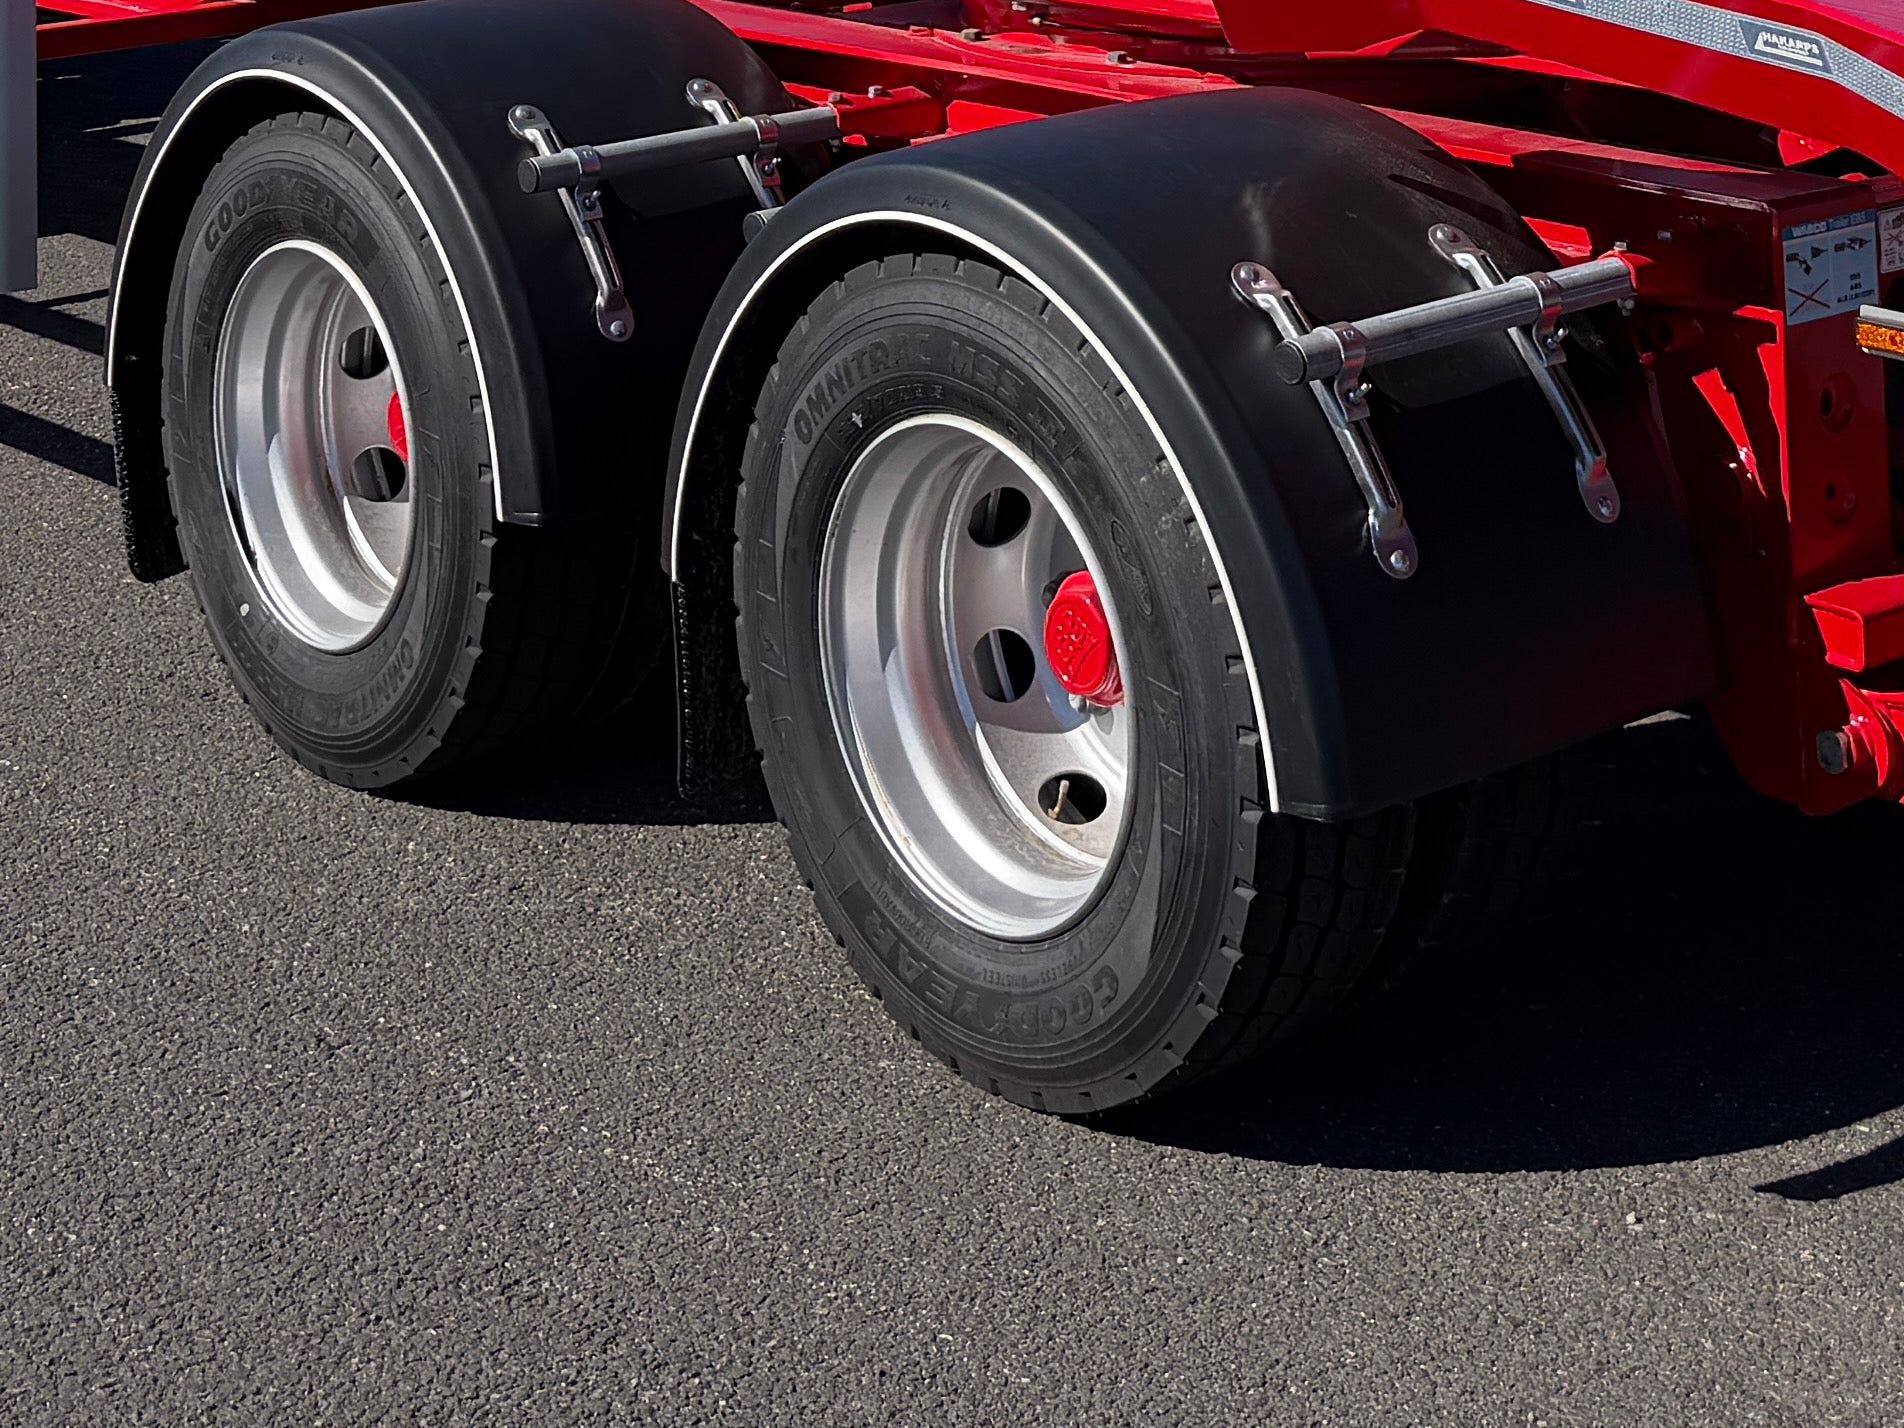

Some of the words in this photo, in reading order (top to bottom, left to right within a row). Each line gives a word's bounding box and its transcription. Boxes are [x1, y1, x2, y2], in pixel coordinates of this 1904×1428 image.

[1762, 32, 1821, 55] HAKARPS
[204, 175, 359, 252] GOODYEAR
[794, 332, 932, 445] OMNITRAC
[864, 910, 1119, 1038] GOODYEAR
